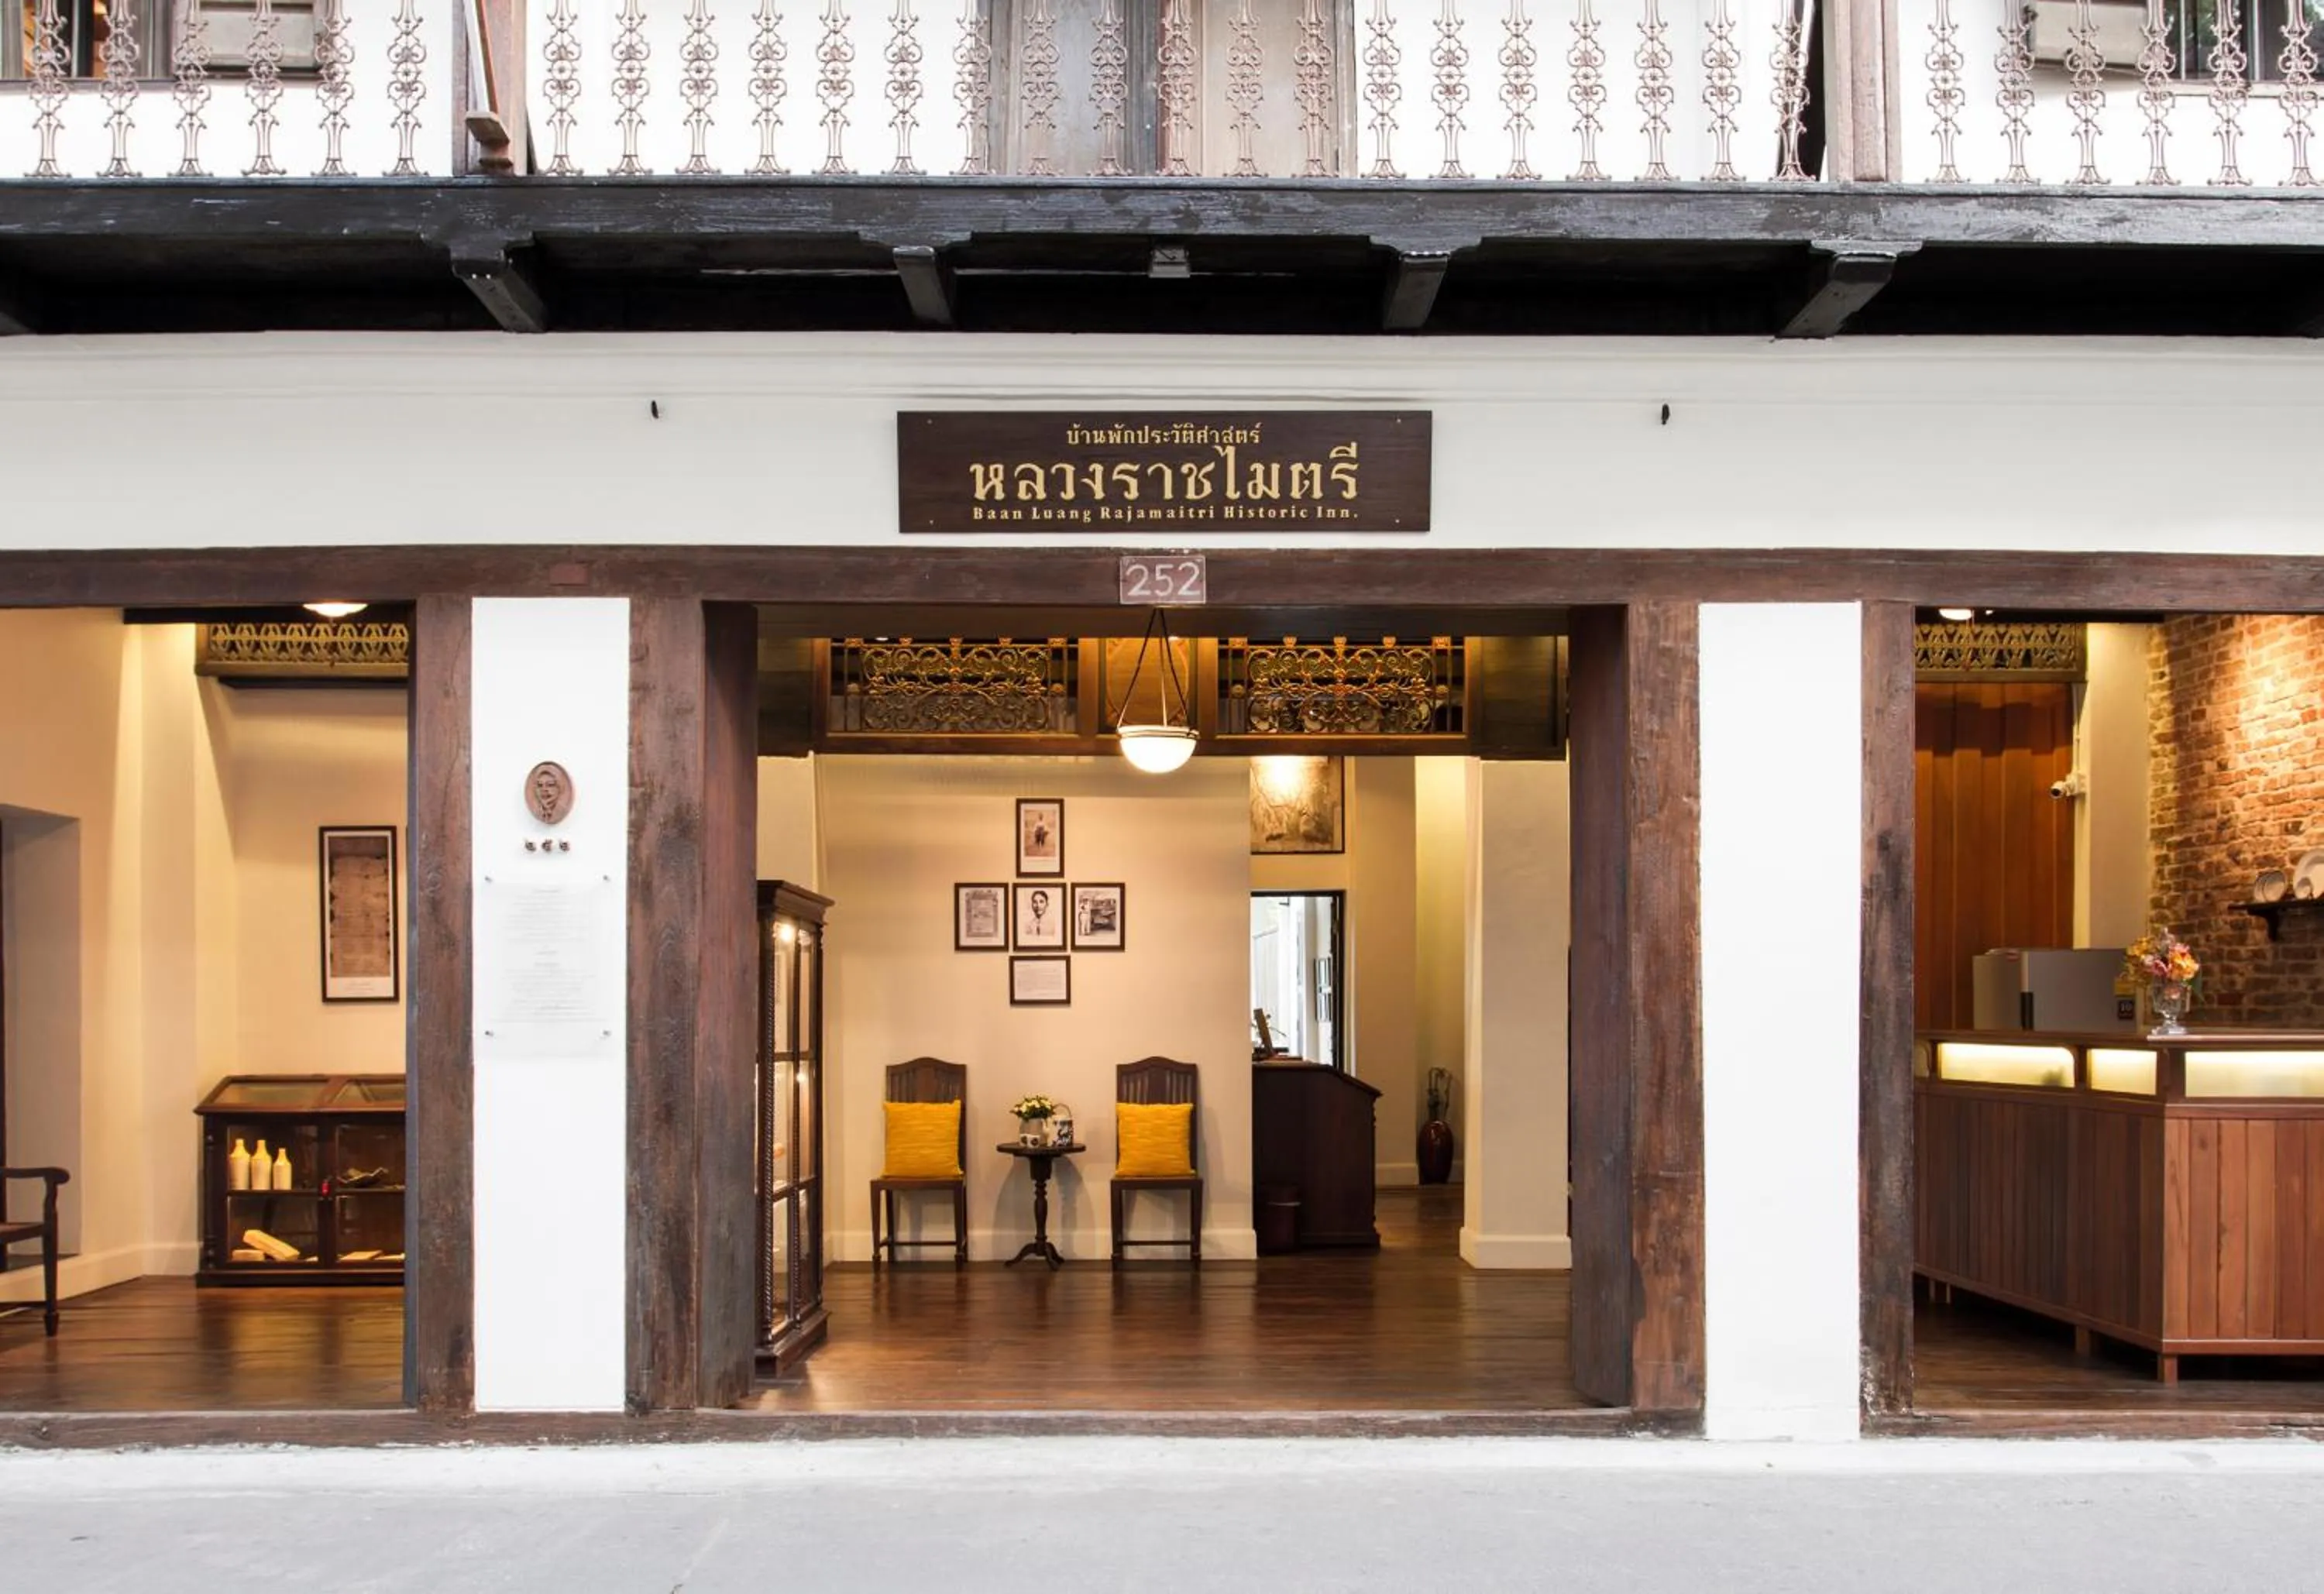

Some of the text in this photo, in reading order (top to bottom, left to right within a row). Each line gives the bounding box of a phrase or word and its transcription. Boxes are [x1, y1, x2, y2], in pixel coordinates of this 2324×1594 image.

[1067, 422, 1262, 445] บ้านพักประวัติศาสตร์
[969, 441, 1359, 500] หลวงราชไมตรี
[973, 506, 1358, 523] Baan Luang Rajamaitri Historic Inn.
[1126, 562, 1200, 596] 252
